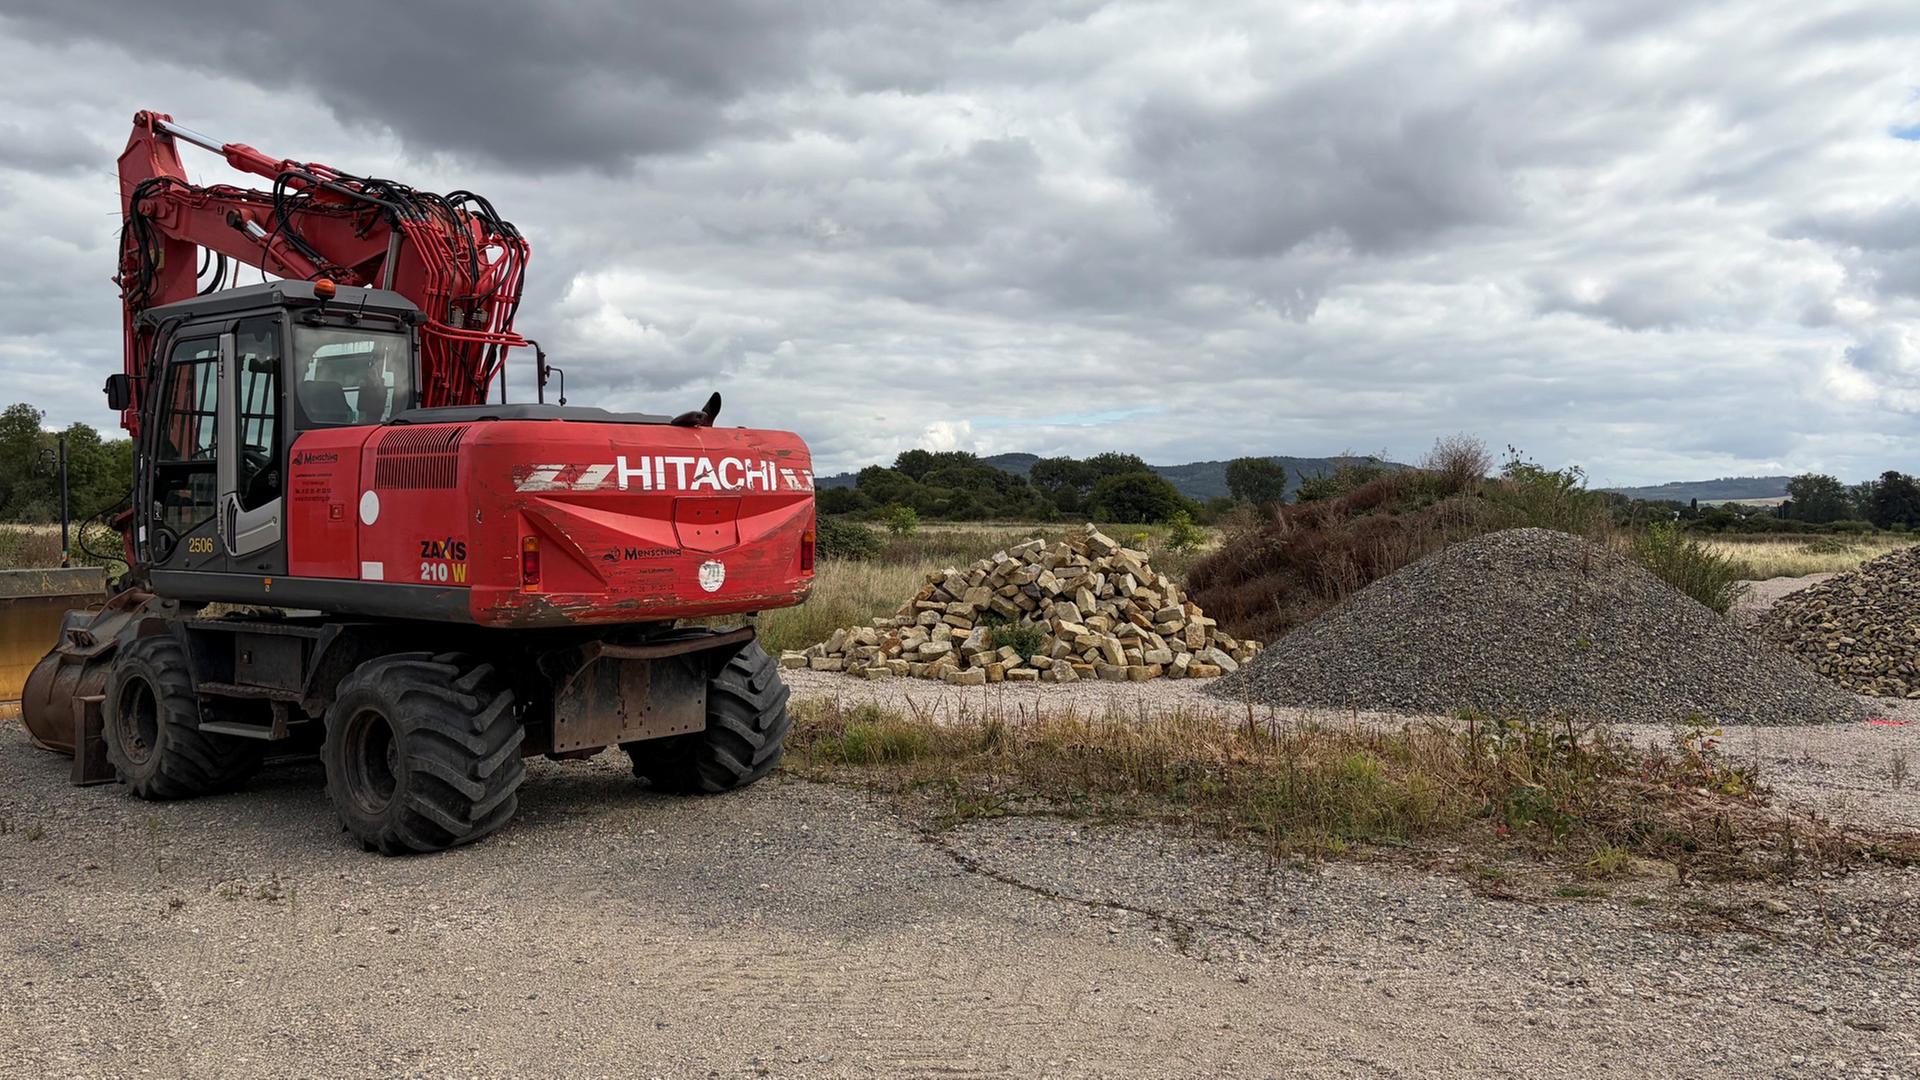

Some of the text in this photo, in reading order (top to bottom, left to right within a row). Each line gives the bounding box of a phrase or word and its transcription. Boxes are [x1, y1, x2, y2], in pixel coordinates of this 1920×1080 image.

[616, 455, 777, 491] HITACHI
[188, 537, 213, 553] 2506
[420, 536, 467, 561] ZAXIS
[420, 562, 467, 583] 210 W
